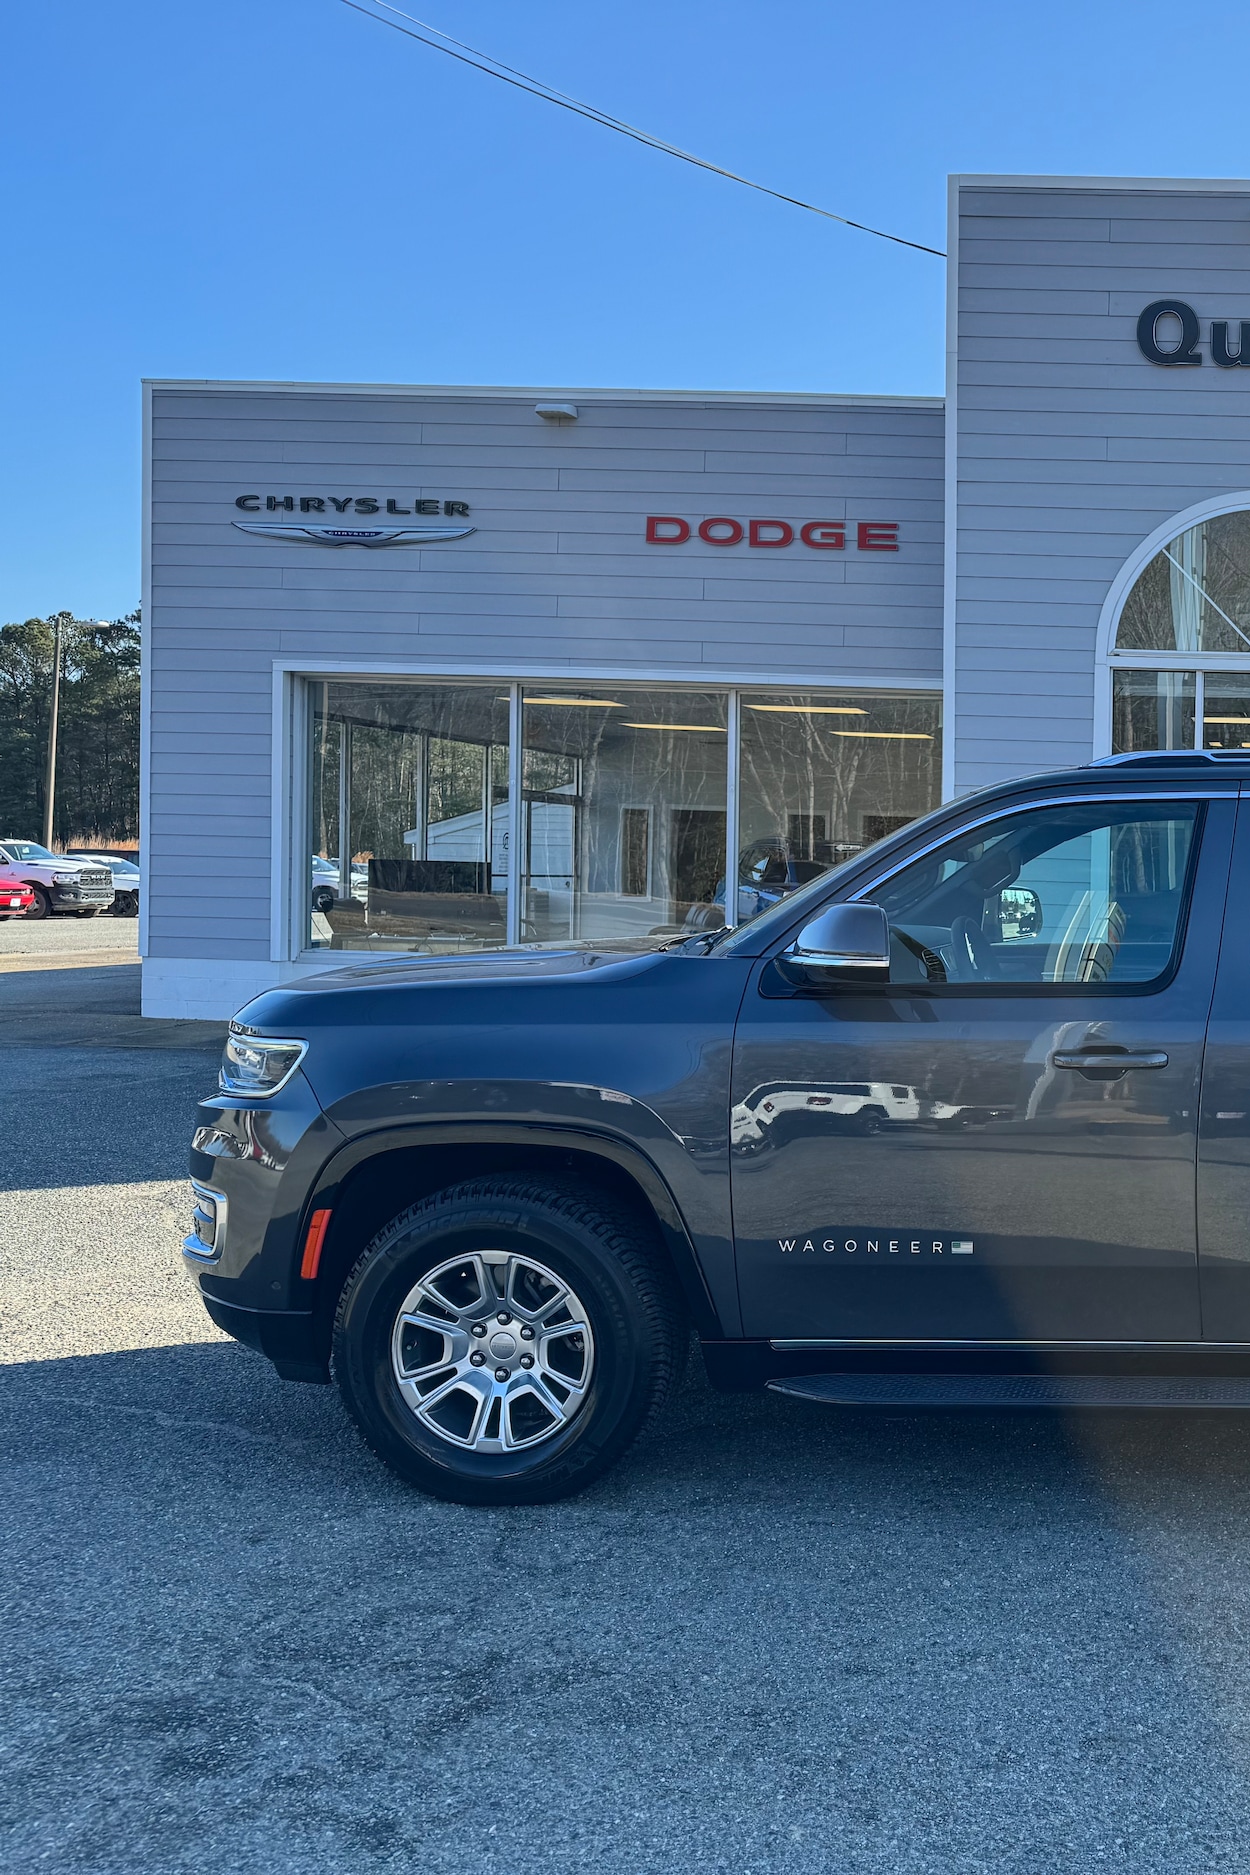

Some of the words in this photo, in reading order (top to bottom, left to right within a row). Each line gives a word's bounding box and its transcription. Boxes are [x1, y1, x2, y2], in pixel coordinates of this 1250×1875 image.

[235, 494, 470, 517] CHRYSLER
[645, 516, 900, 551] DODGE
[778, 1239, 943, 1254] WAGONEER
